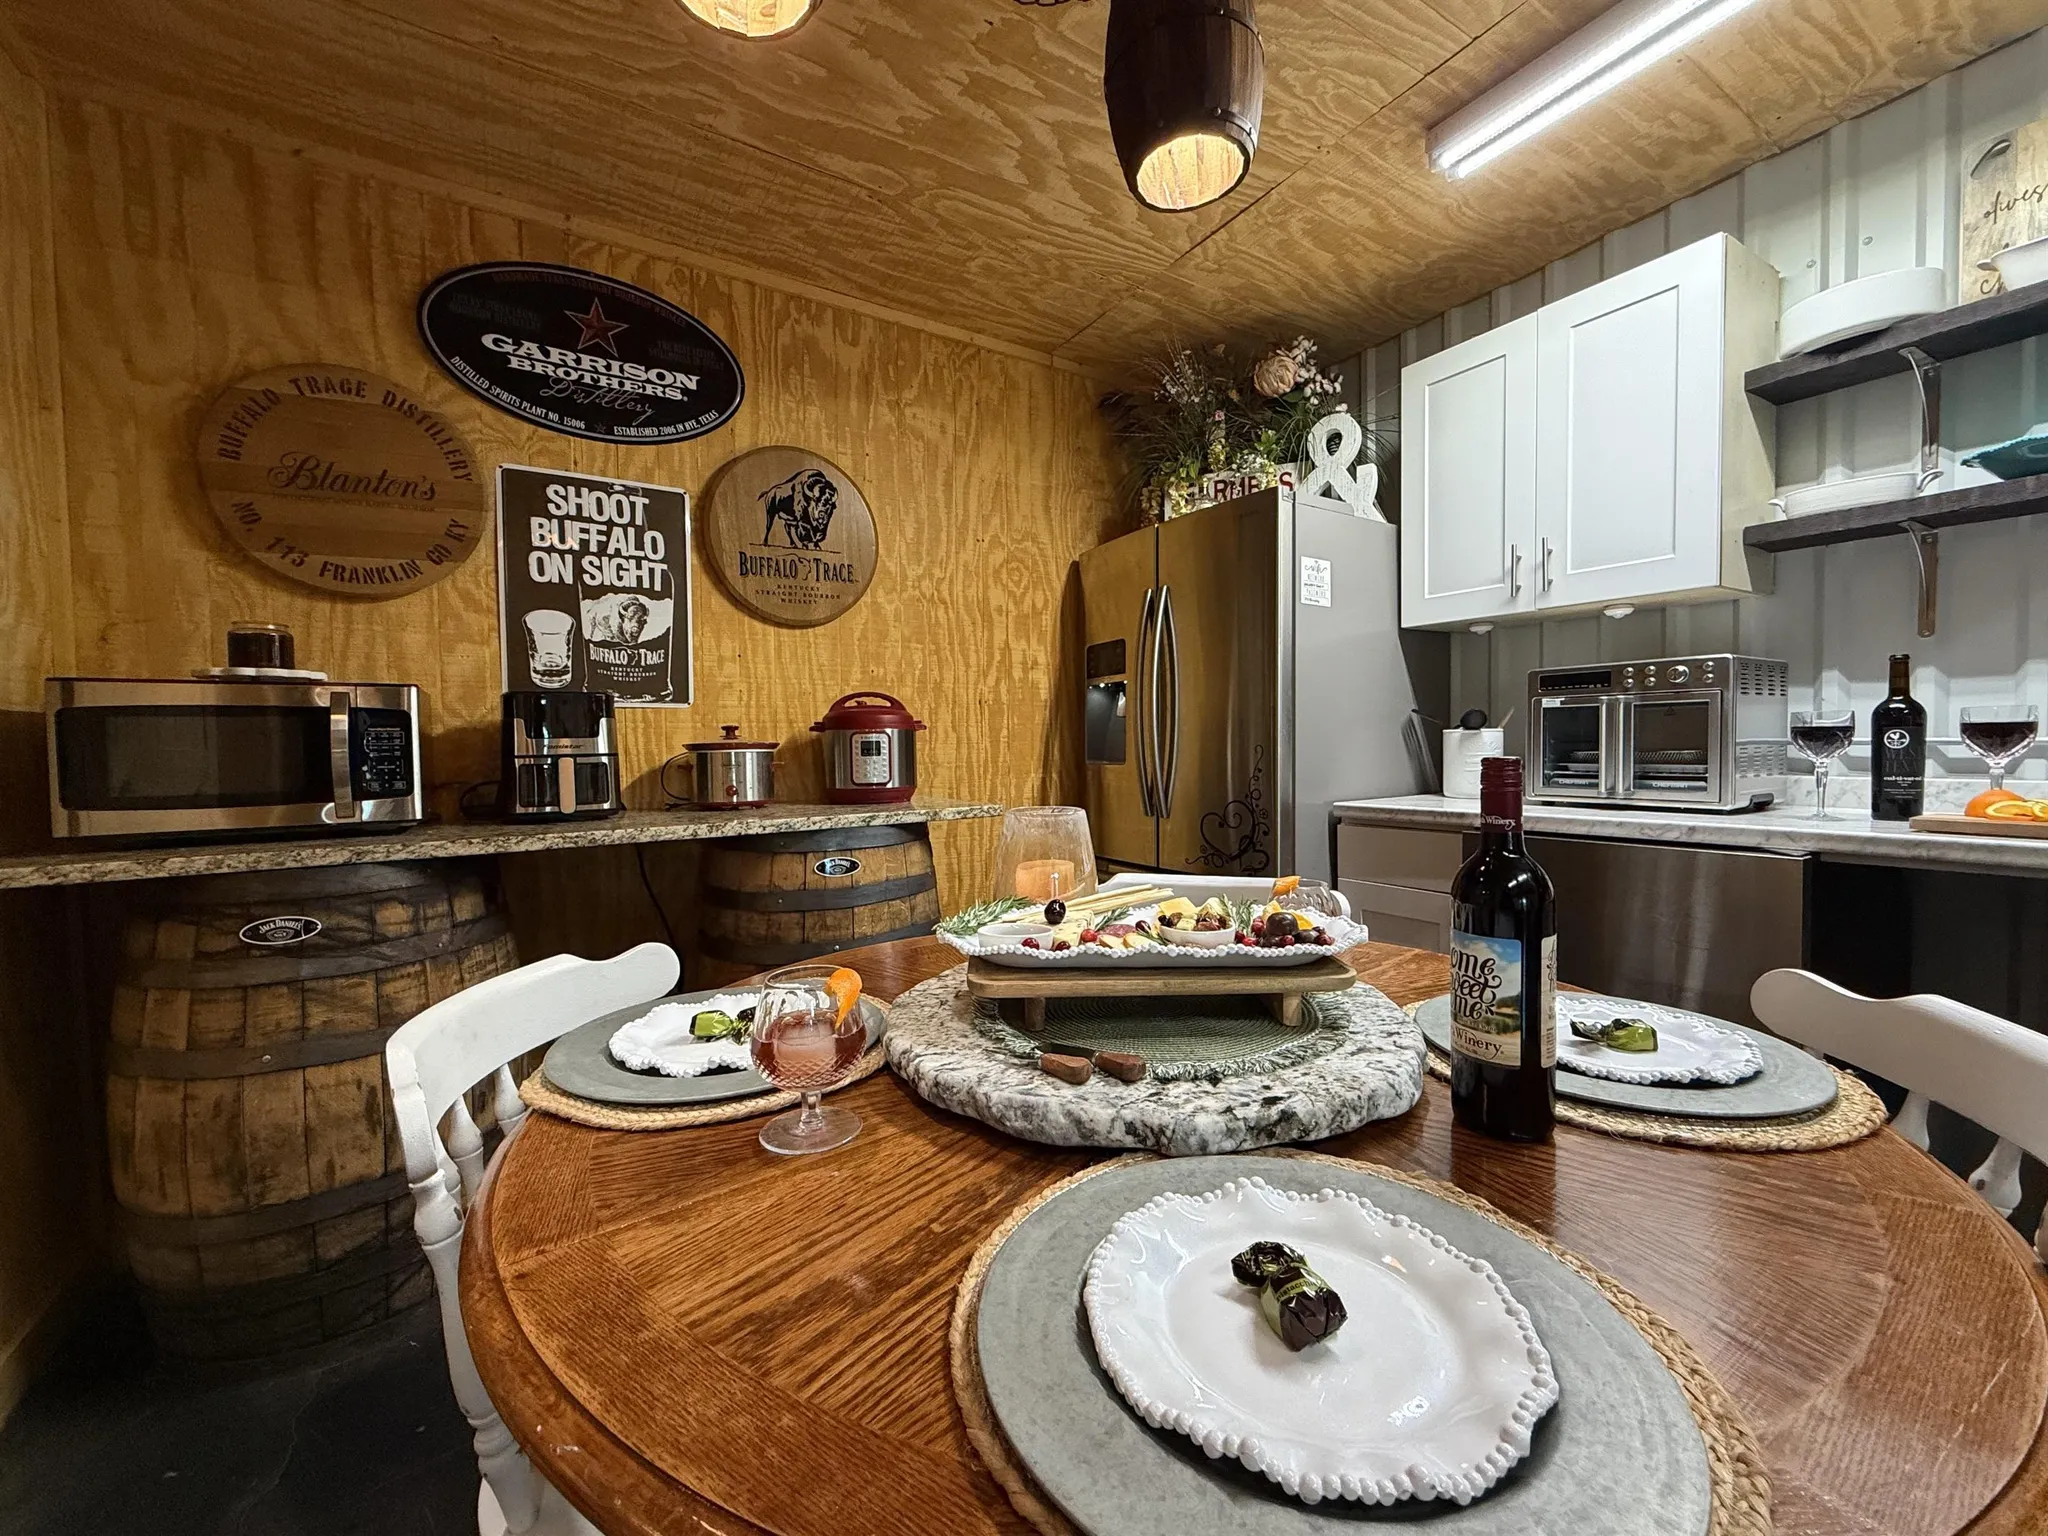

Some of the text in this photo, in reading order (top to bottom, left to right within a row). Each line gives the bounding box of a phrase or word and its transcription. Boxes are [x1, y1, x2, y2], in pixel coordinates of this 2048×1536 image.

[1983, 183, 2048, 225] olives
[481, 333, 701, 391] GARRISON
[451, 356, 586, 430] DISTILLED SPIRITS PLANT NO. 15006
[540, 376, 655, 426] Distillery
[216, 376, 473, 483] BUFFALO TRACE DISTILLERY
[613, 426, 659, 436] ESTABLISHED
[659, 425, 676, 435] 2006
[675, 423, 686, 432] IN
[698, 409, 719, 425] TEXAS
[267, 451, 437, 501] Blanton's
[545, 483, 649, 526] SHOOT
[231, 501, 262, 532] NO.
[318, 559, 424, 585] FRANKLIN
[425, 543, 452, 566] CO
[444, 518, 469, 543] KY
[530, 516, 665, 561] BUFFALO
[528, 551, 668, 591] ON SIGHT
[738, 551, 854, 584] BUFFALO TRACE
[777, 584, 820, 592] KENTUCKY
[755, 589, 797, 597] STRAIGHT
[589, 643, 665, 666] BUFFALO TRACE
[1486, 815, 1516, 830] Winery
[258, 919, 301, 934] JACK DANIEL'S
[1454, 1026, 1502, 1060] Winery
